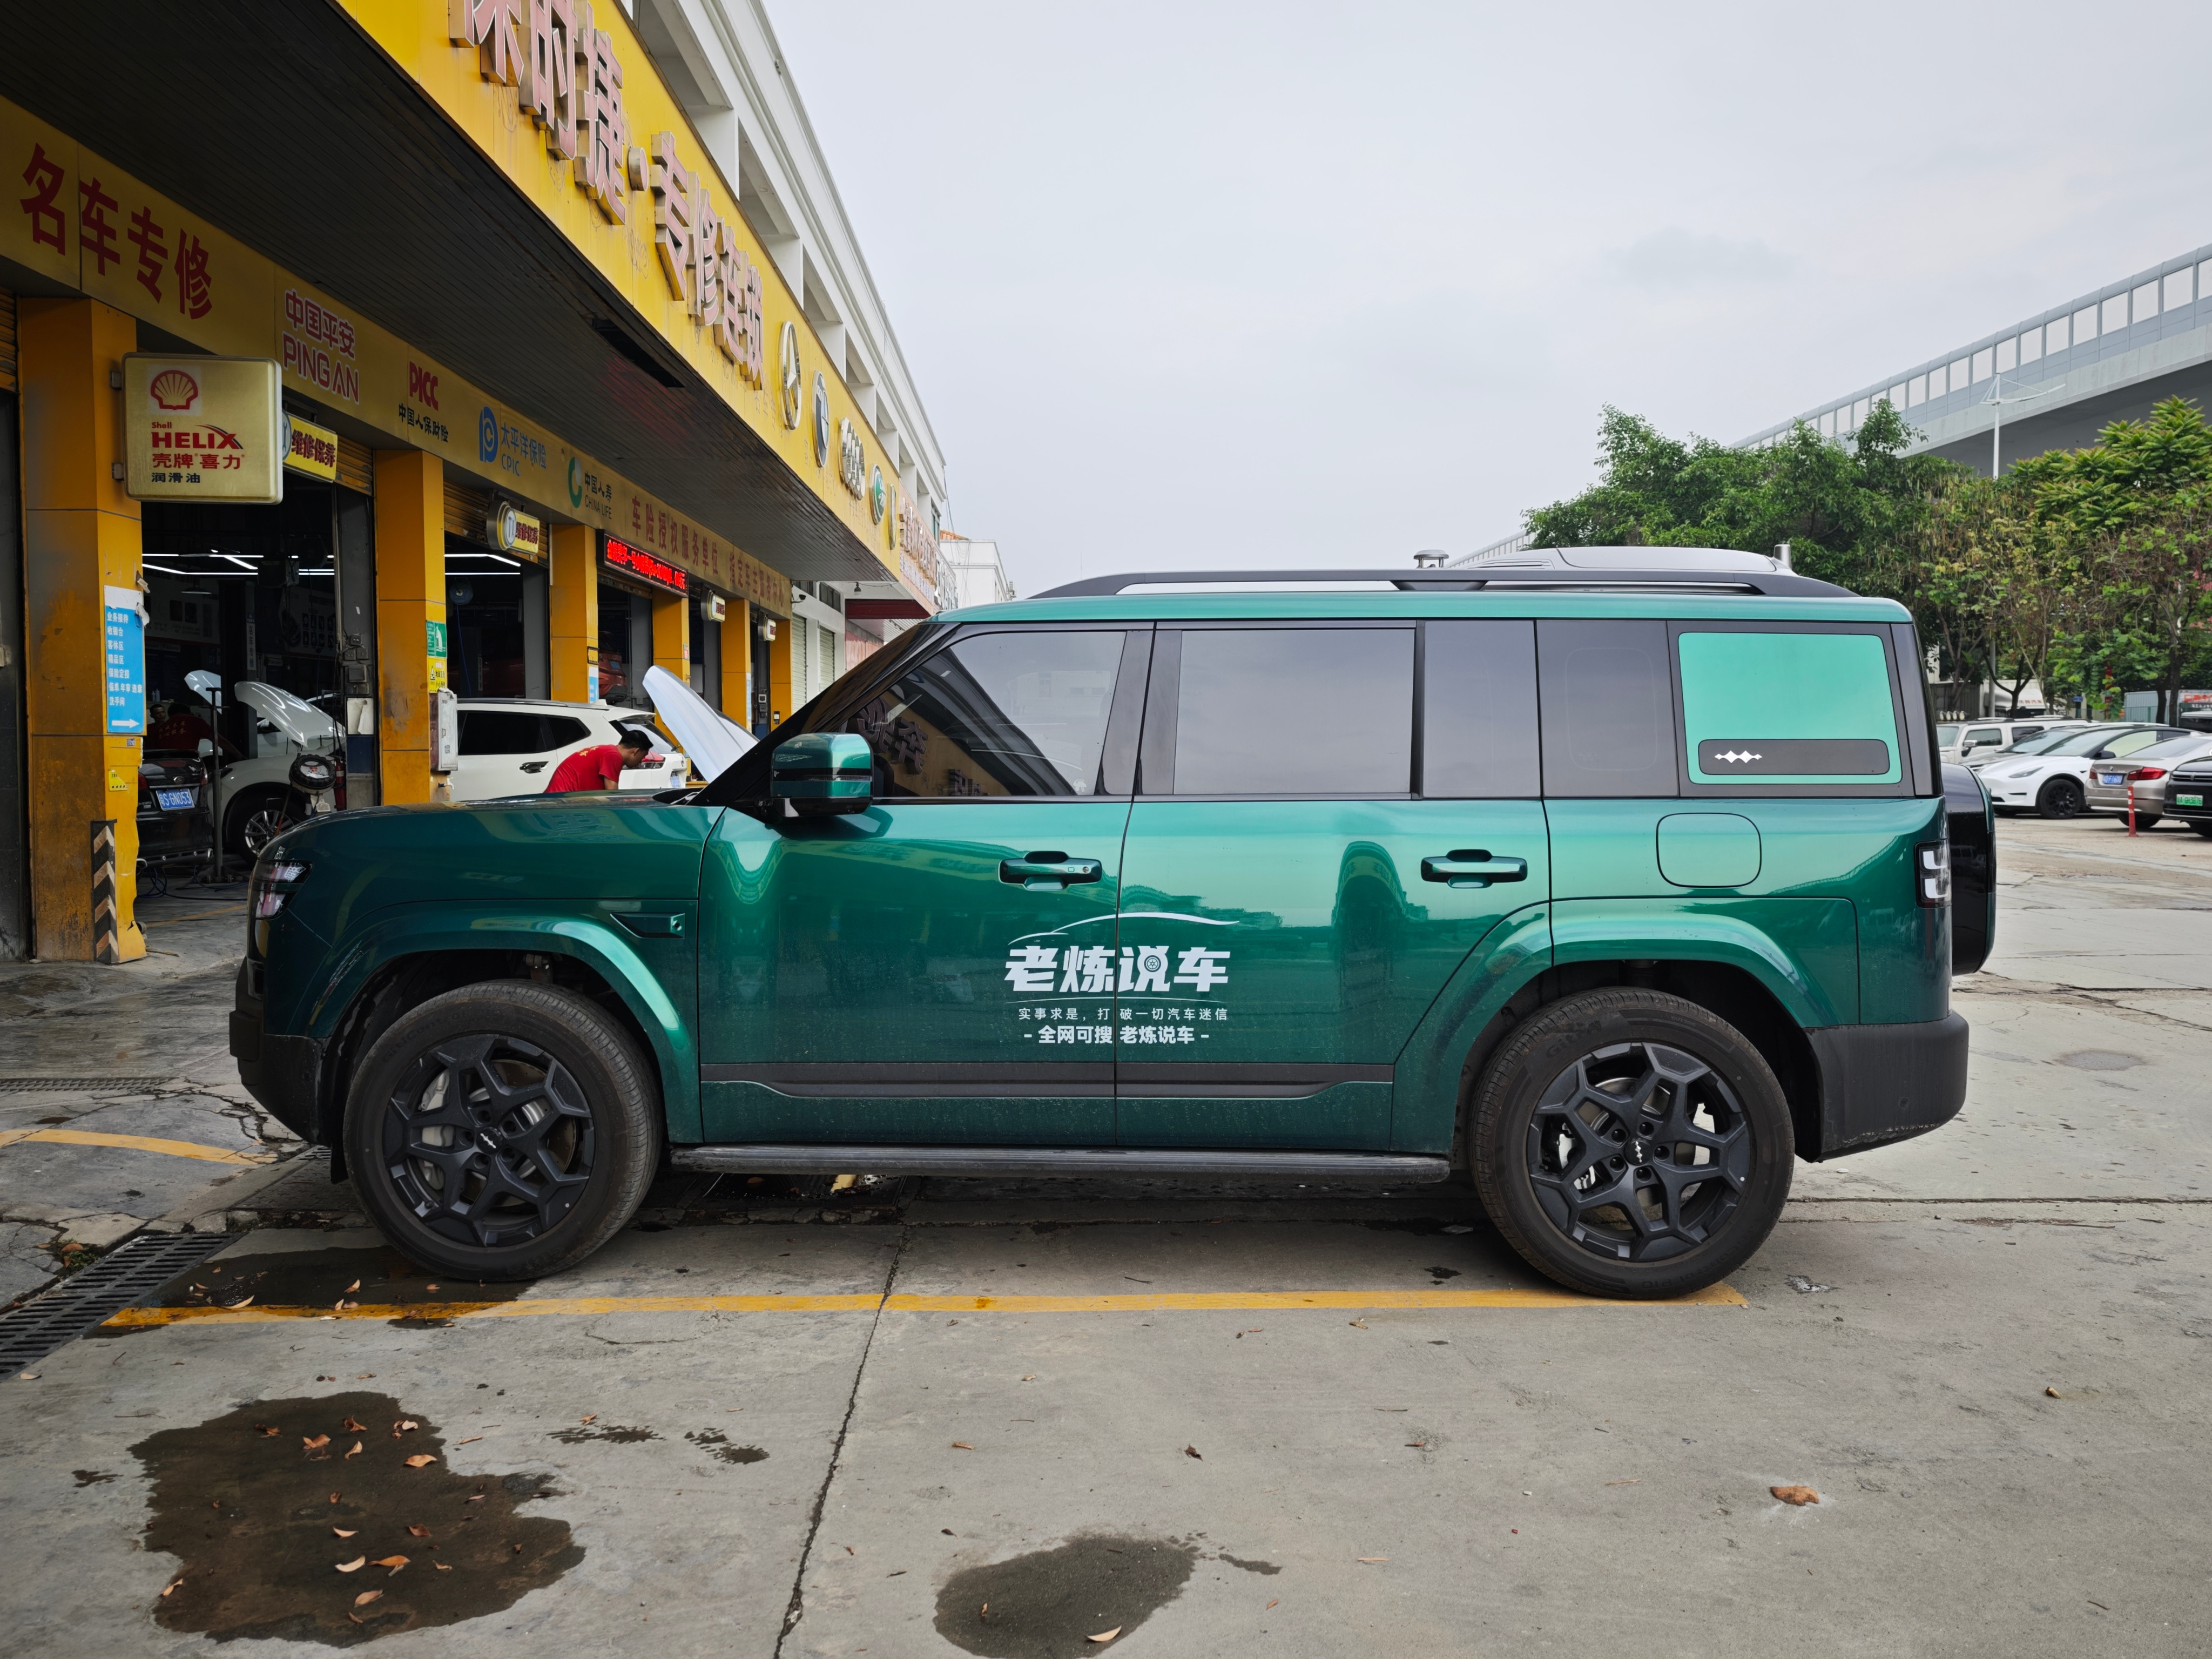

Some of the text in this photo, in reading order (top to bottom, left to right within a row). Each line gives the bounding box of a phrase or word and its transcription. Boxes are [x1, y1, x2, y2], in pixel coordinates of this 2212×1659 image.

[19, 143, 212, 319] 名车专修
[284, 287, 355, 359] 中国平安
[409, 361, 439, 410] PICC
[399, 402, 449, 443] 中国人保财险
[151, 430, 243, 449] HELIX
[292, 429, 335, 468] 维修保养
[501, 422, 547, 469] 太平洋保险
[151, 472, 200, 483] 润滑油
[501, 453, 521, 476] CPIC
[584, 470, 612, 503] 中国人寿
[585, 495, 612, 520] CHINA LIFE
[631, 495, 719, 575] 车险授权服务单位
[107, 611, 128, 623] 业务接待
[107, 625, 124, 637] 收银台
[108, 654, 124, 665] 精品区
[109, 697, 125, 706] 洗手间
[1004, 945, 1231, 993] 老炼说车
